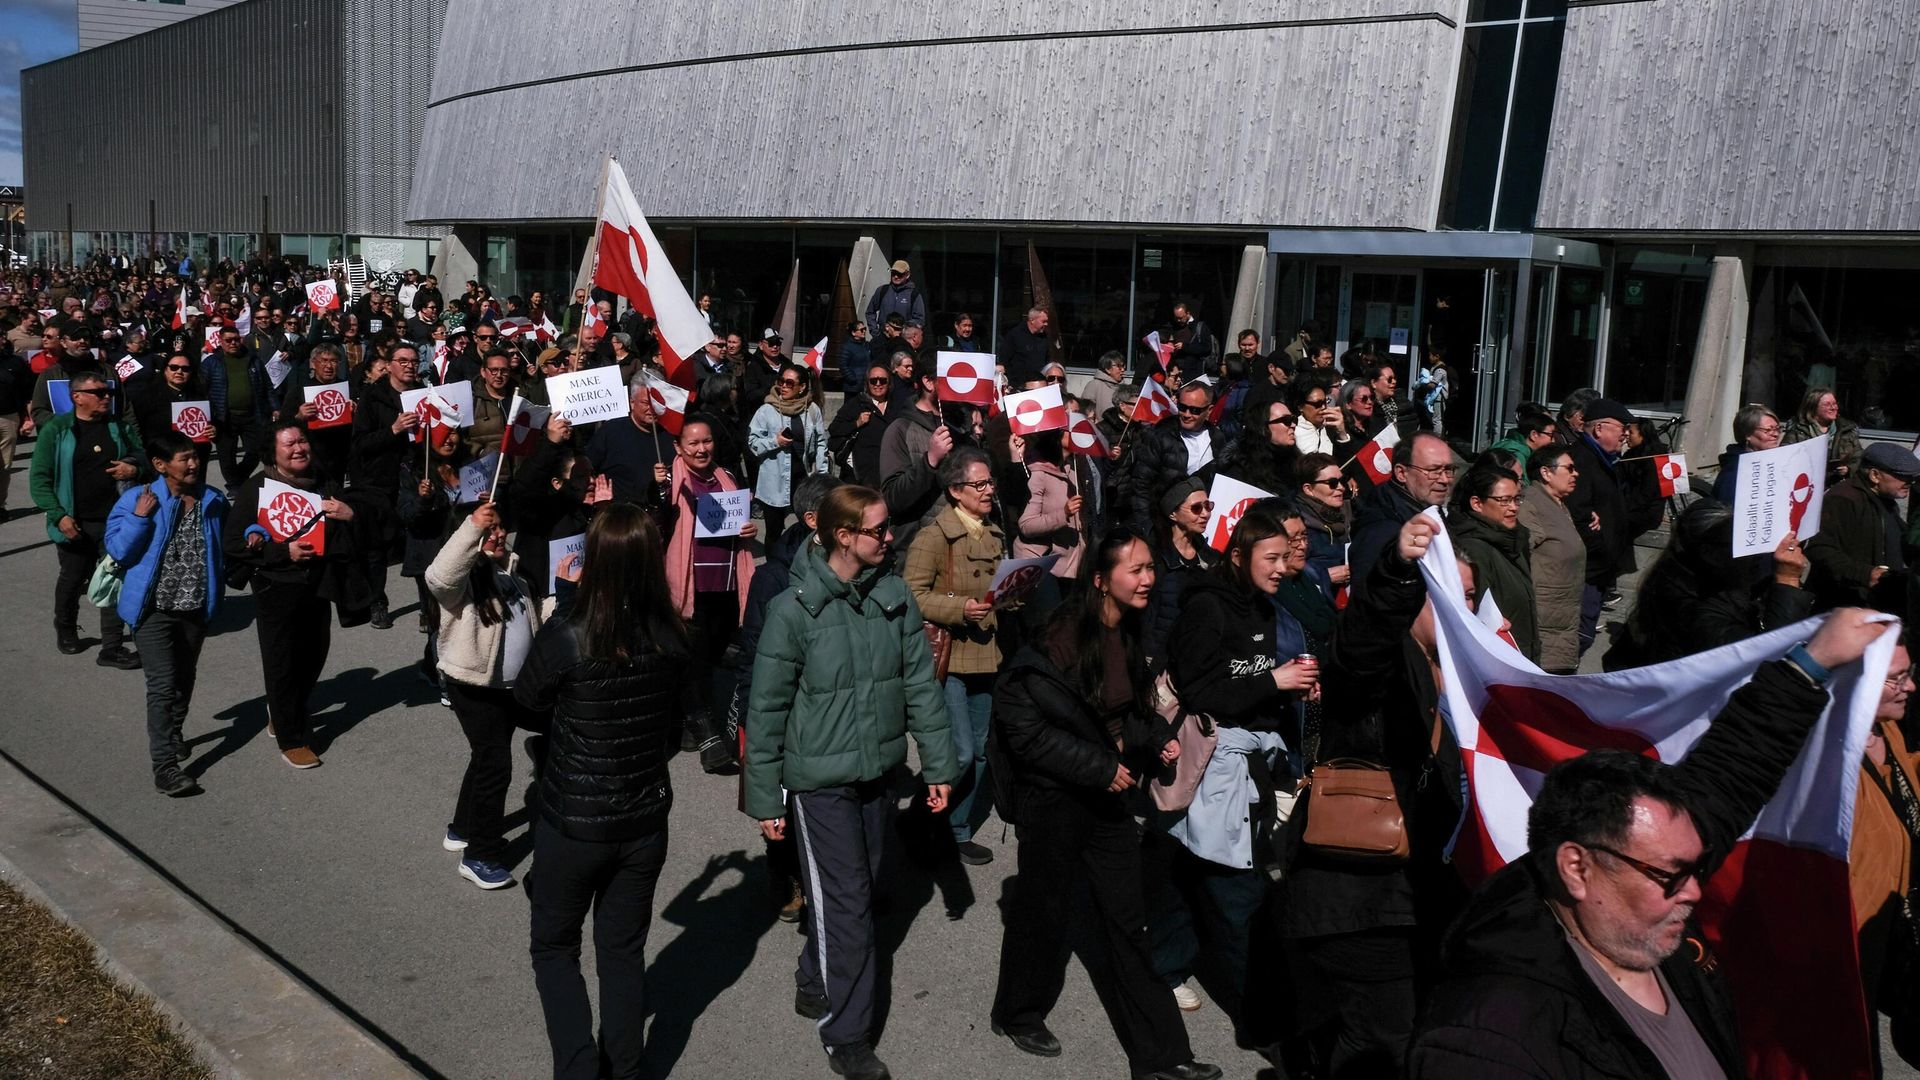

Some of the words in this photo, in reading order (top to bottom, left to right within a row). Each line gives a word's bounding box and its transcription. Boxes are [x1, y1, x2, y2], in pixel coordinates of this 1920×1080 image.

[569, 375, 601, 389] MAKE
[315, 391, 344, 408] USA
[564, 388, 613, 405] AMERICA
[179, 407, 206, 422] USA
[562, 408, 579, 420] GO
[581, 402, 619, 417] AWAY!!
[179, 421, 206, 436] ASU
[1751, 461, 1761, 501] nunaat
[275, 493, 316, 518] USA
[712, 498, 724, 506] WE
[726, 497, 741, 505] ARE
[707, 510, 726, 519] NOT
[728, 509, 744, 518] FOR
[712, 522, 733, 531] SALE
[1745, 502, 1758, 547] Kalaallit
[1761, 500, 1774, 545] Kalaallit
[566, 541, 585, 553] MAK
